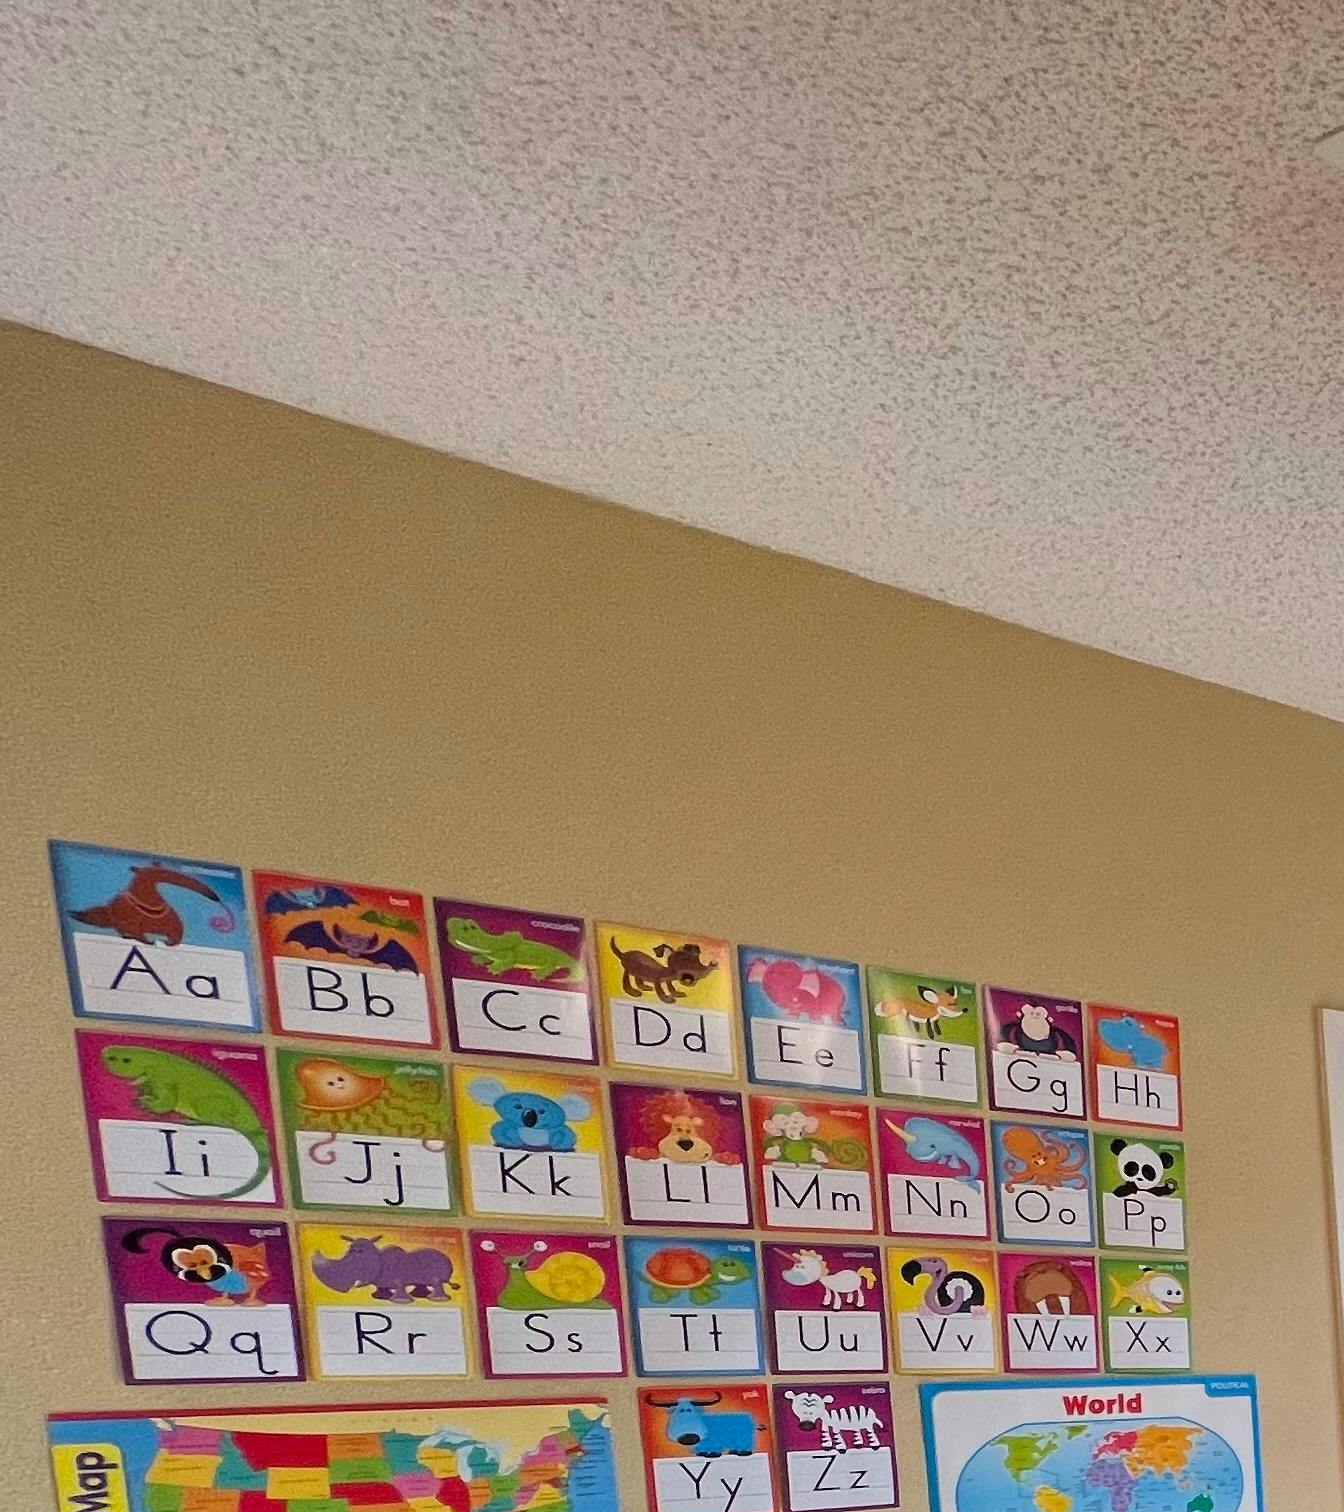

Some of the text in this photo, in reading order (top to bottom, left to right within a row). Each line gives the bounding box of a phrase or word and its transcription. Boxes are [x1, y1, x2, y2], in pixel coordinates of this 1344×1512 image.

[531, 920, 580, 933] crocodile
[109, 946, 221, 1000] Aa
[307, 967, 395, 1020] Bb
[481, 989, 562, 1037] Cc
[633, 1010, 708, 1055] Dd
[777, 1026, 835, 1069] Ee
[907, 1043, 949, 1082] Ff
[1007, 1059, 1069, 1113] Gg
[1113, 1071, 1162, 1110] Hh
[158, 1129, 212, 1179] Ii
[344, 1141, 407, 1207] Jj
[499, 1152, 574, 1198] Kk
[664, 1164, 709, 1205] Ll
[772, 1173, 862, 1213] Mm
[906, 1180, 968, 1221] Nn
[1014, 1189, 1077, 1227] Oo
[1123, 1199, 1168, 1247] Pp
[145, 1310, 279, 1376] Qq
[355, 1312, 427, 1356] Rr
[523, 1313, 584, 1355] Ss
[671, 1314, 722, 1353] Tt
[797, 1316, 859, 1354] Uu
[918, 1318, 975, 1353] Vv
[1013, 1318, 1089, 1353] Ww
[1126, 1321, 1171, 1354] Xx
[1062, 1393, 1142, 1415] World
[811, 1454, 871, 1493] Zz
